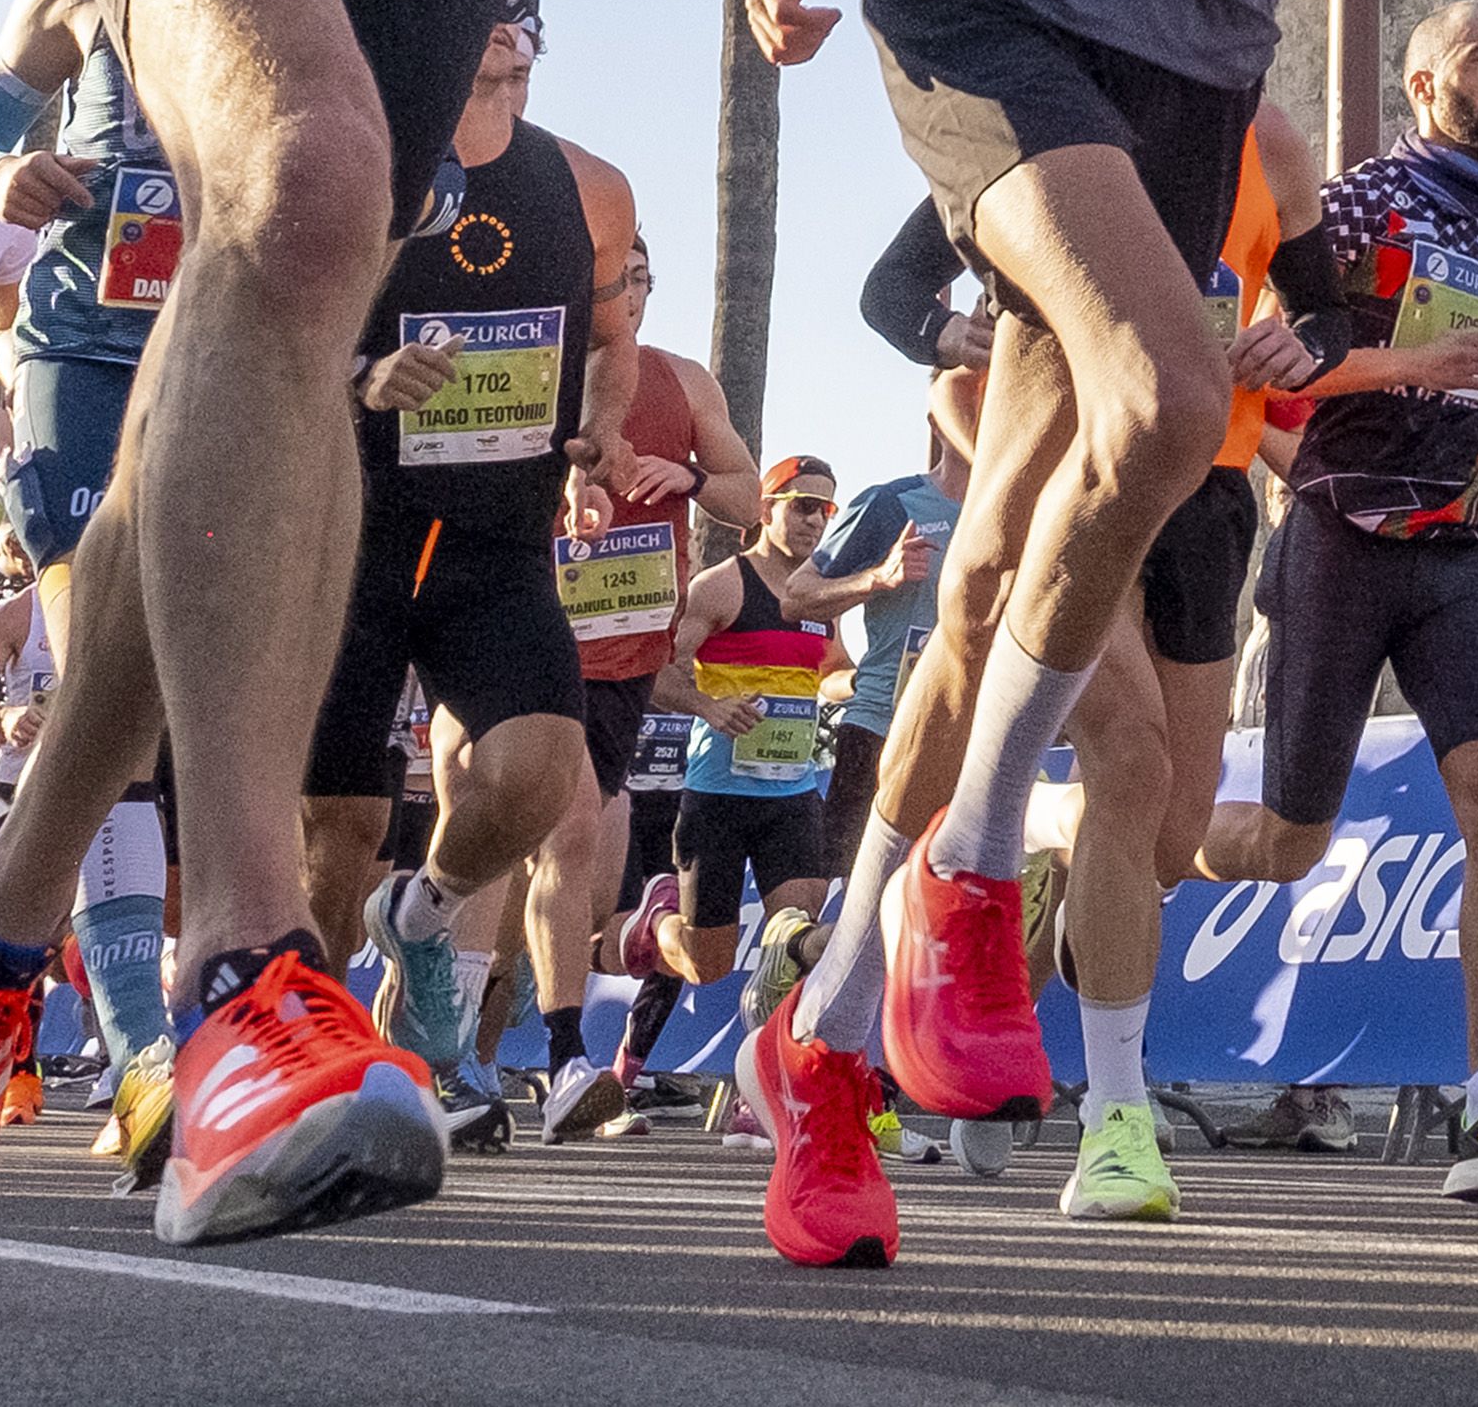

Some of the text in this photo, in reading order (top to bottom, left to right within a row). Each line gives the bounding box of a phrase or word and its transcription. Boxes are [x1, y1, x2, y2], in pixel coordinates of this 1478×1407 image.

[459, 322, 544, 344] ZURICH
[463, 371, 512, 395] 1702
[416, 406, 470, 428] TIAGO
[597, 532, 661, 554] ZURICH
[601, 569, 638, 589] 1243
[564, 597, 617, 616] MANUEL
[659, 721, 691, 734] ZURIC
